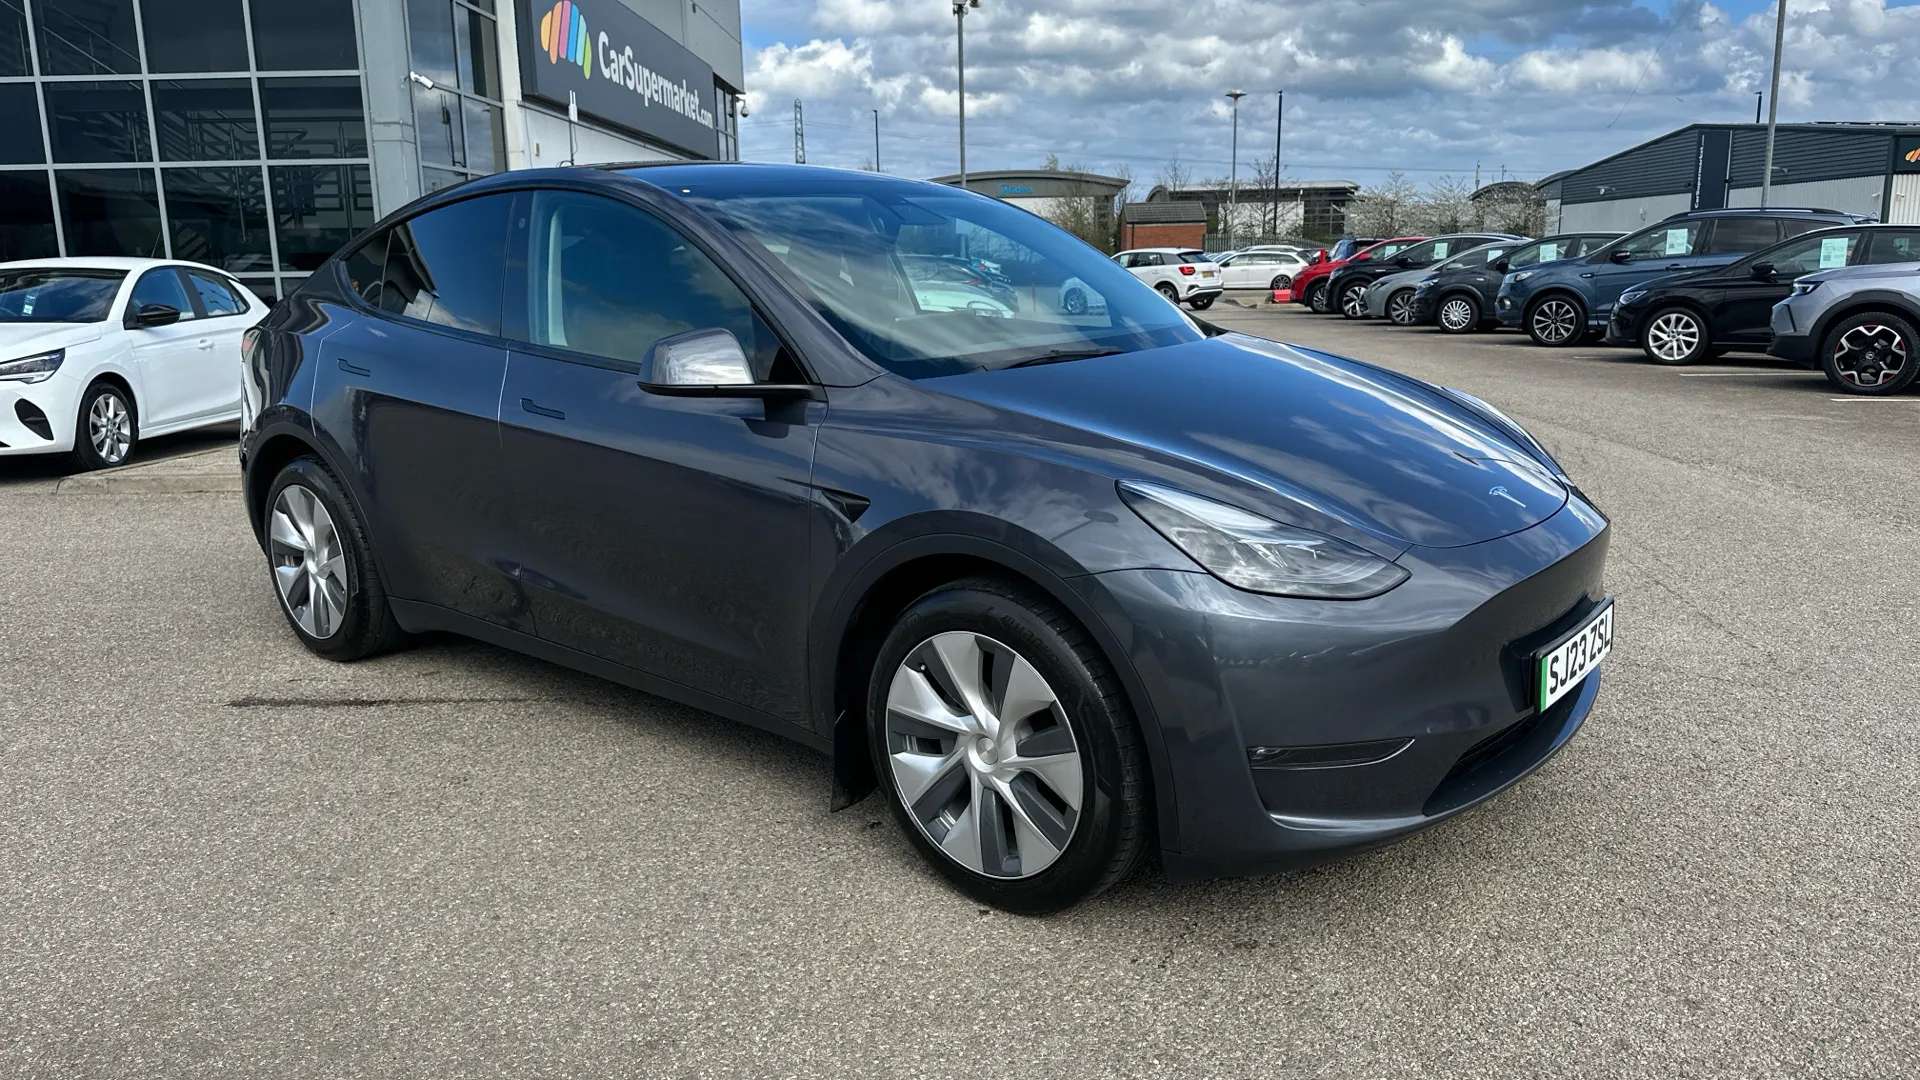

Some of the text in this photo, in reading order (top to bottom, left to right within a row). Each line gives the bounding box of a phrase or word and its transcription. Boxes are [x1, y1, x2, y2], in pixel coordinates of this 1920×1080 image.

[598, 31, 713, 130] CarSupermarket.com
[1550, 613, 1610, 695] SJ23 ZSL
